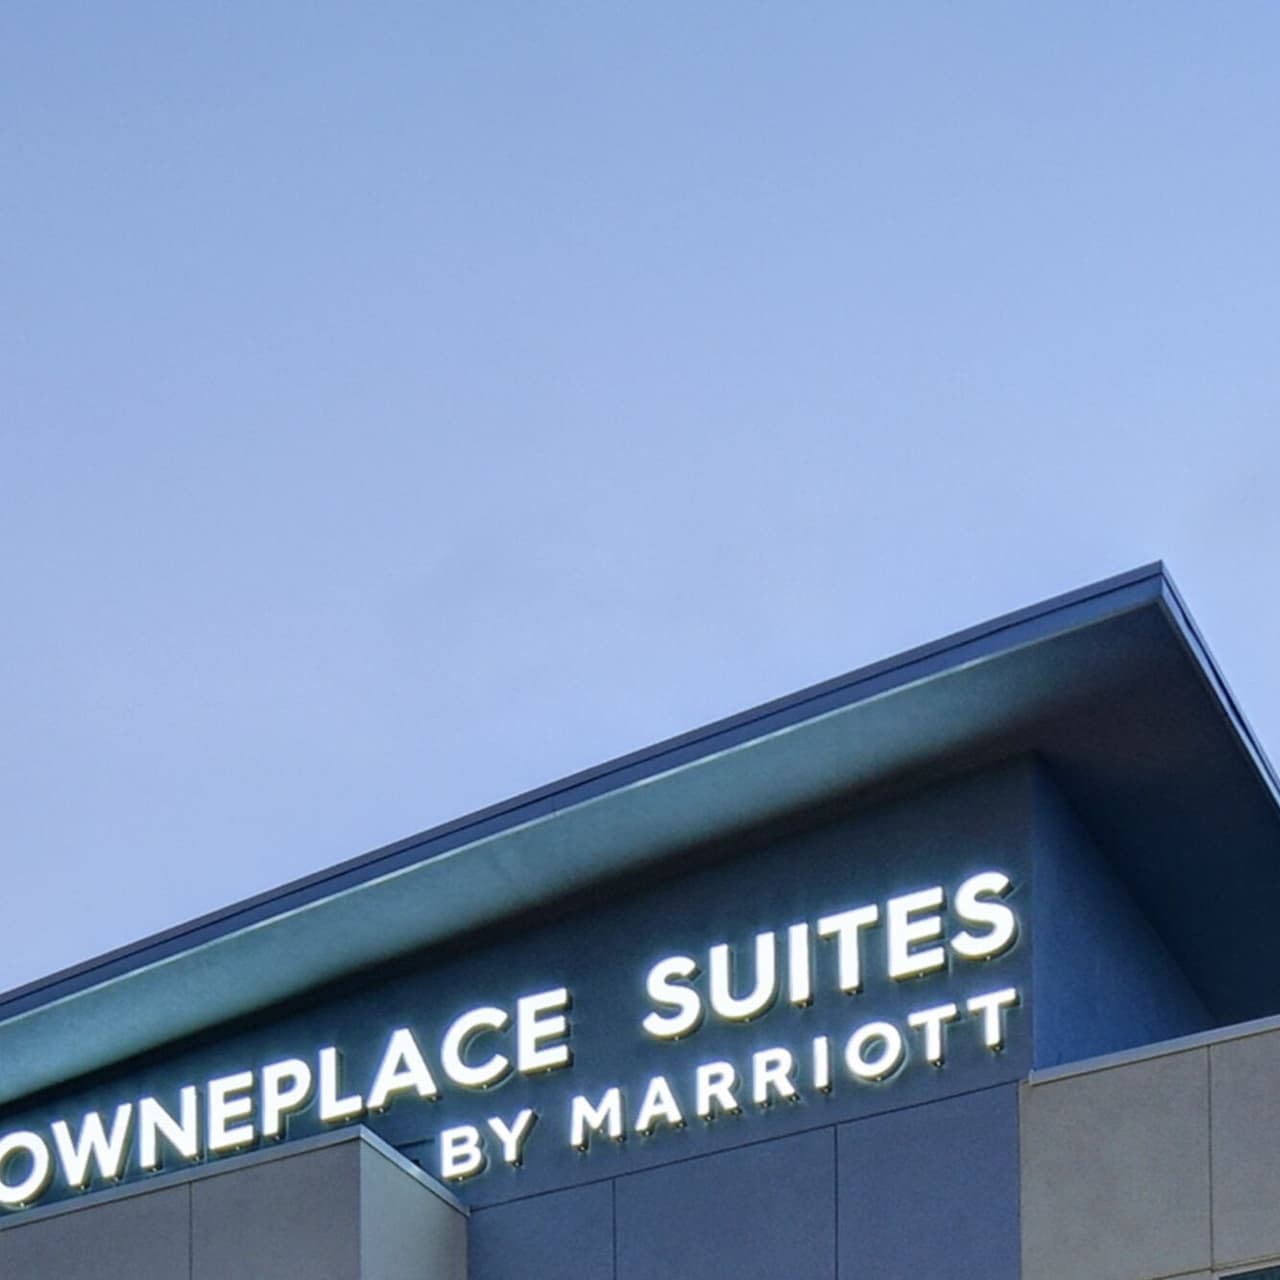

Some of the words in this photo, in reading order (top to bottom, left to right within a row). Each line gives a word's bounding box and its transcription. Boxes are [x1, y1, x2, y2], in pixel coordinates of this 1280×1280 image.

[0, 987, 571, 1203] OWNEPLACE
[643, 871, 1017, 1041] SUITES
[440, 1110, 533, 1179] BY
[571, 988, 1018, 1150] MARRIOTT
